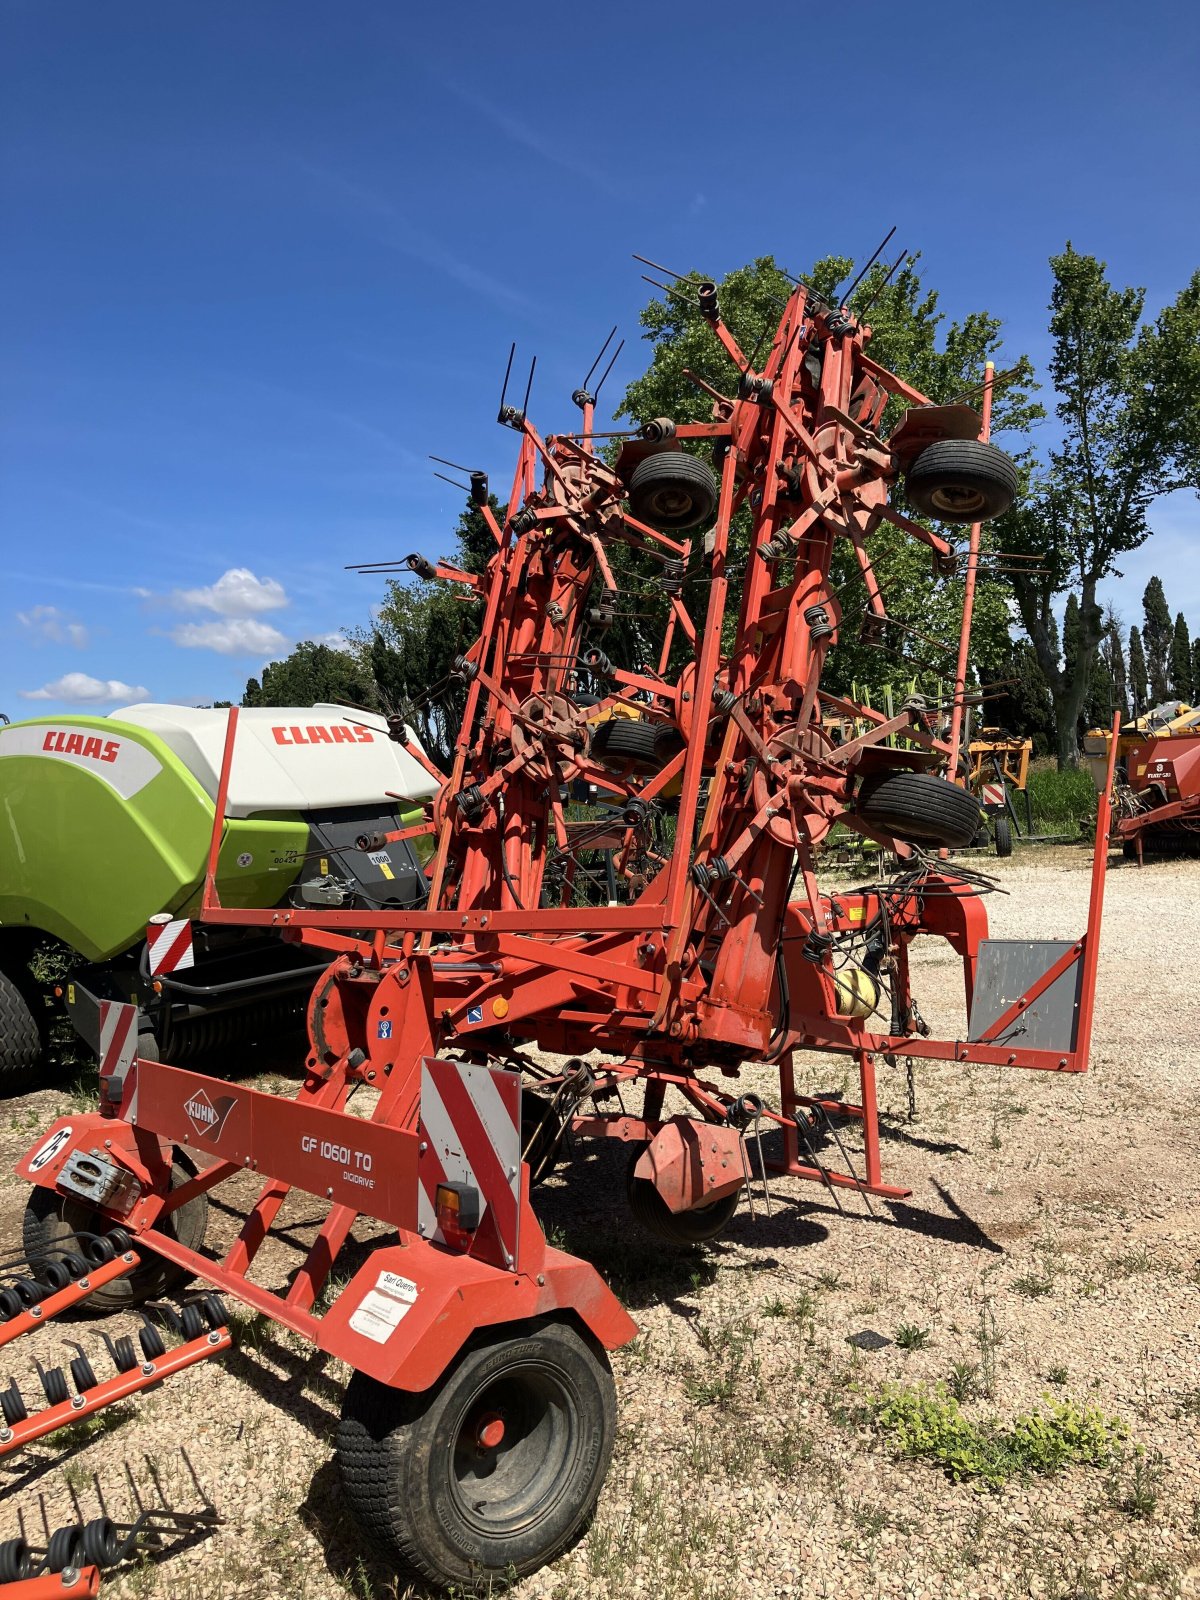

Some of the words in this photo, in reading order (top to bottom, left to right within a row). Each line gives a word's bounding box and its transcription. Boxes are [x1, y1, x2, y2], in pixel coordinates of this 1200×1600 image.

[272, 726, 374, 744] CLAAS
[43, 732, 120, 762] CLAAS
[372, 855, 389, 864] 1000
[188, 1101, 214, 1124] KUHN
[31, 1130, 71, 1169] 25
[302, 1136, 317, 1153] GF
[321, 1141, 351, 1165] 10601
[355, 1151, 372, 1172] TO
[343, 1171, 375, 1189] DIGIDRIVE
